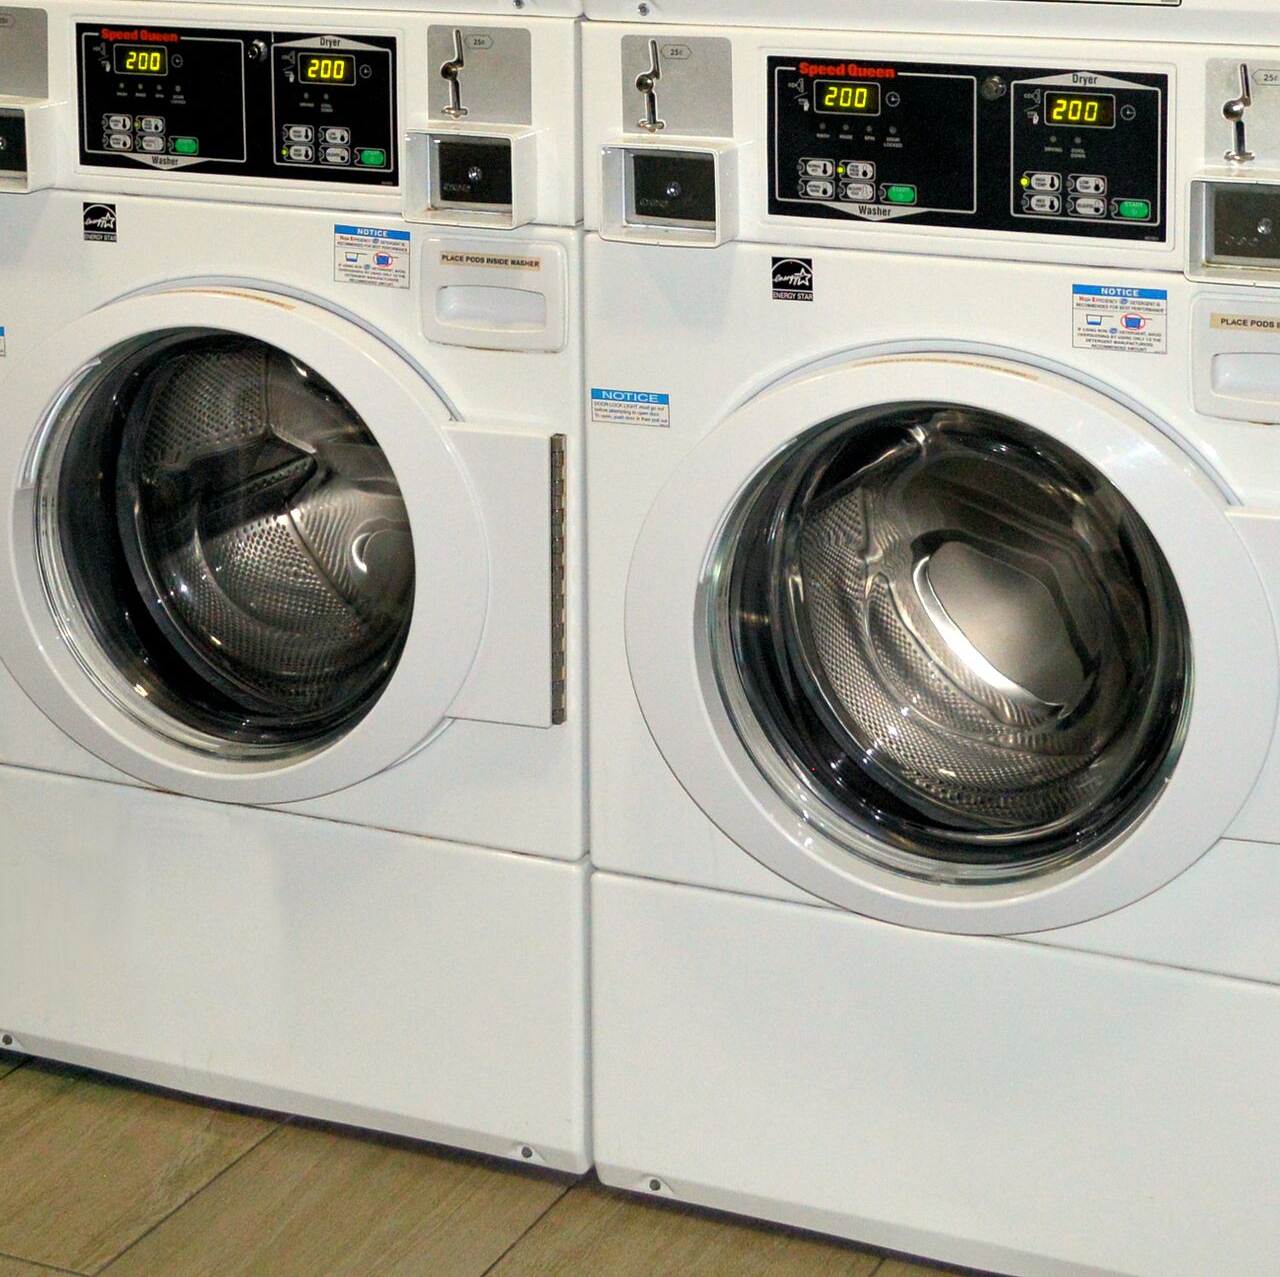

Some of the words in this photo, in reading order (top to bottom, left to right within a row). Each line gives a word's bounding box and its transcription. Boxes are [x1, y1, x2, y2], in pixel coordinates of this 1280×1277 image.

[101, 28, 138, 41] Speed
[140, 30, 178, 42] Queen
[320, 38, 340, 47] Dryer
[126, 52, 160, 70] 200
[308, 60, 344, 78] 200
[799, 62, 845, 76] Speed
[847, 63, 896, 77] Queen
[1072, 74, 1097, 85] Dryer
[825, 87, 867, 107] 200
[1053, 100, 1098, 121] 200
[152, 156, 178, 165] Washer
[858, 205, 891, 216] Washer
[357, 228, 388, 237] NOTICE
[442, 255, 464, 263] PLACE
[466, 256, 485, 264] PODS
[486, 257, 509, 266] INSIDE
[510, 259, 539, 267] WASHER
[773, 291, 796, 299] ENERGY
[797, 292, 813, 300] STAR
[1101, 288, 1140, 297] NOTICE
[1221, 318, 1248, 327] PLACE
[1250, 320, 1275, 328] PODS
[602, 390, 659, 403] NOTICE
